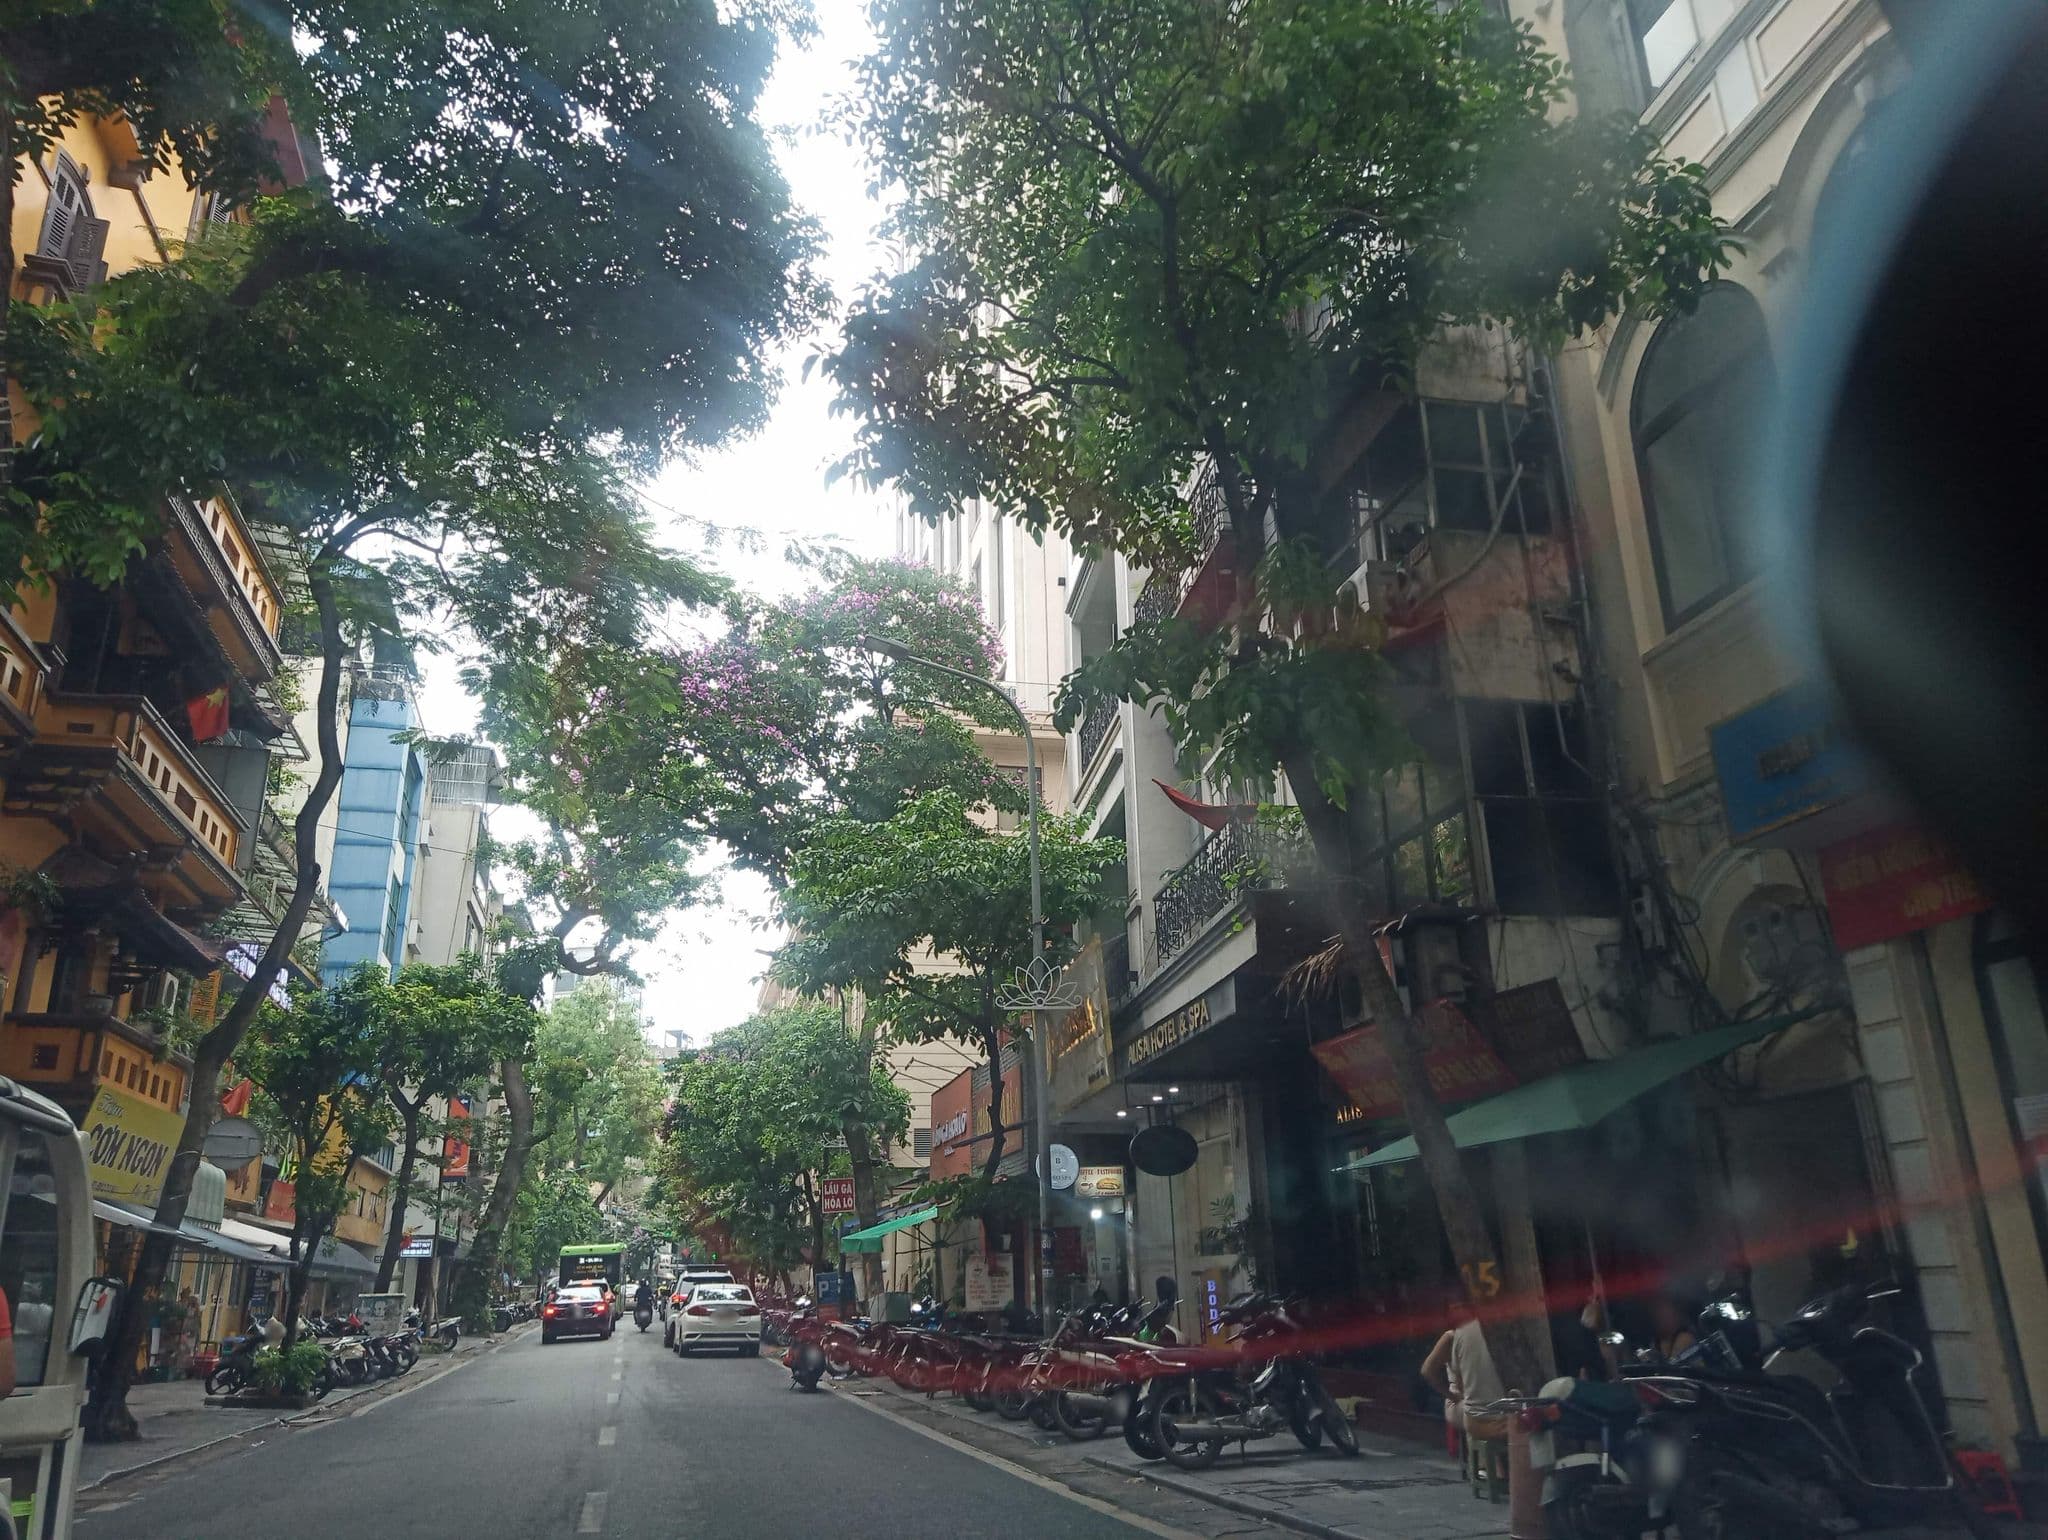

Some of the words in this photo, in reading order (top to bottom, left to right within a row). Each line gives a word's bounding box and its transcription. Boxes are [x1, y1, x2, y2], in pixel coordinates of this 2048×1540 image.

[1151, 1017, 1177, 1053] HOTEL
[1179, 1012, 1189, 1036] &
[1189, 998, 1209, 1031] SPA
[117, 1134, 169, 1178] NGON
[1207, 1280, 1220, 1335] BODY
